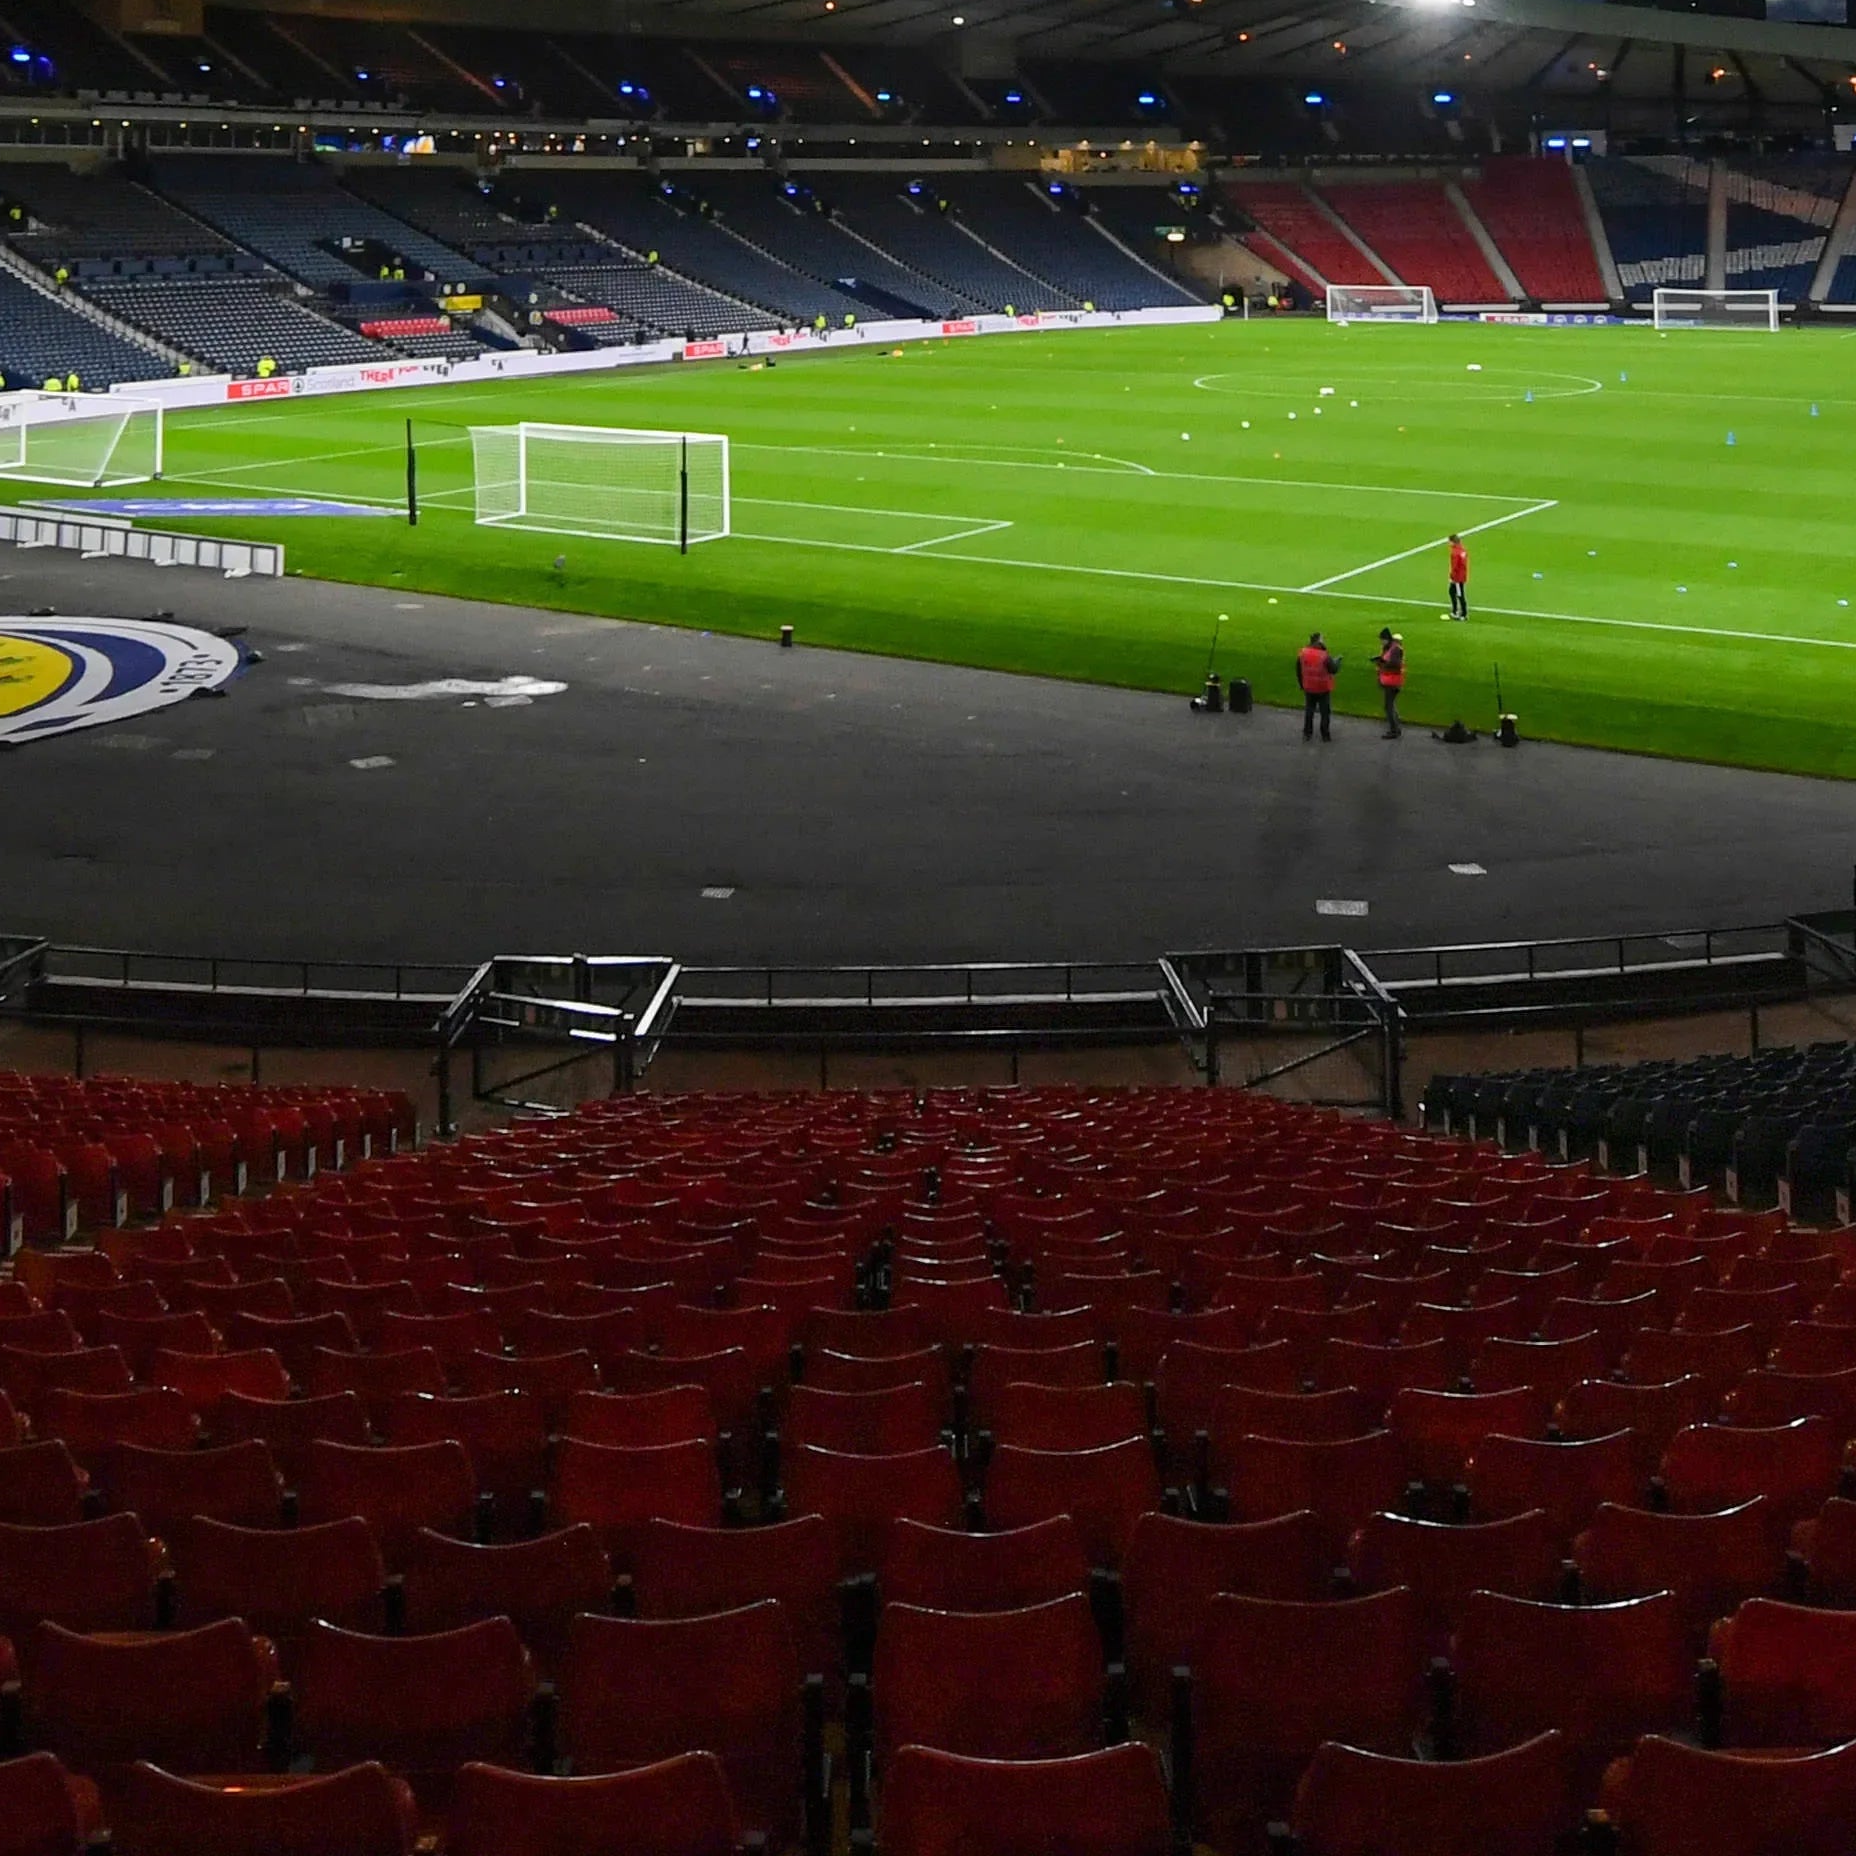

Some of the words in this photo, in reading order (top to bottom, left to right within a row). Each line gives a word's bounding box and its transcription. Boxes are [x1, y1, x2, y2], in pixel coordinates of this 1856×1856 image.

[241, 381, 289, 396] SPAR
[307, 376, 354, 392] Scotland
[160, 659, 223, 686] 1873
